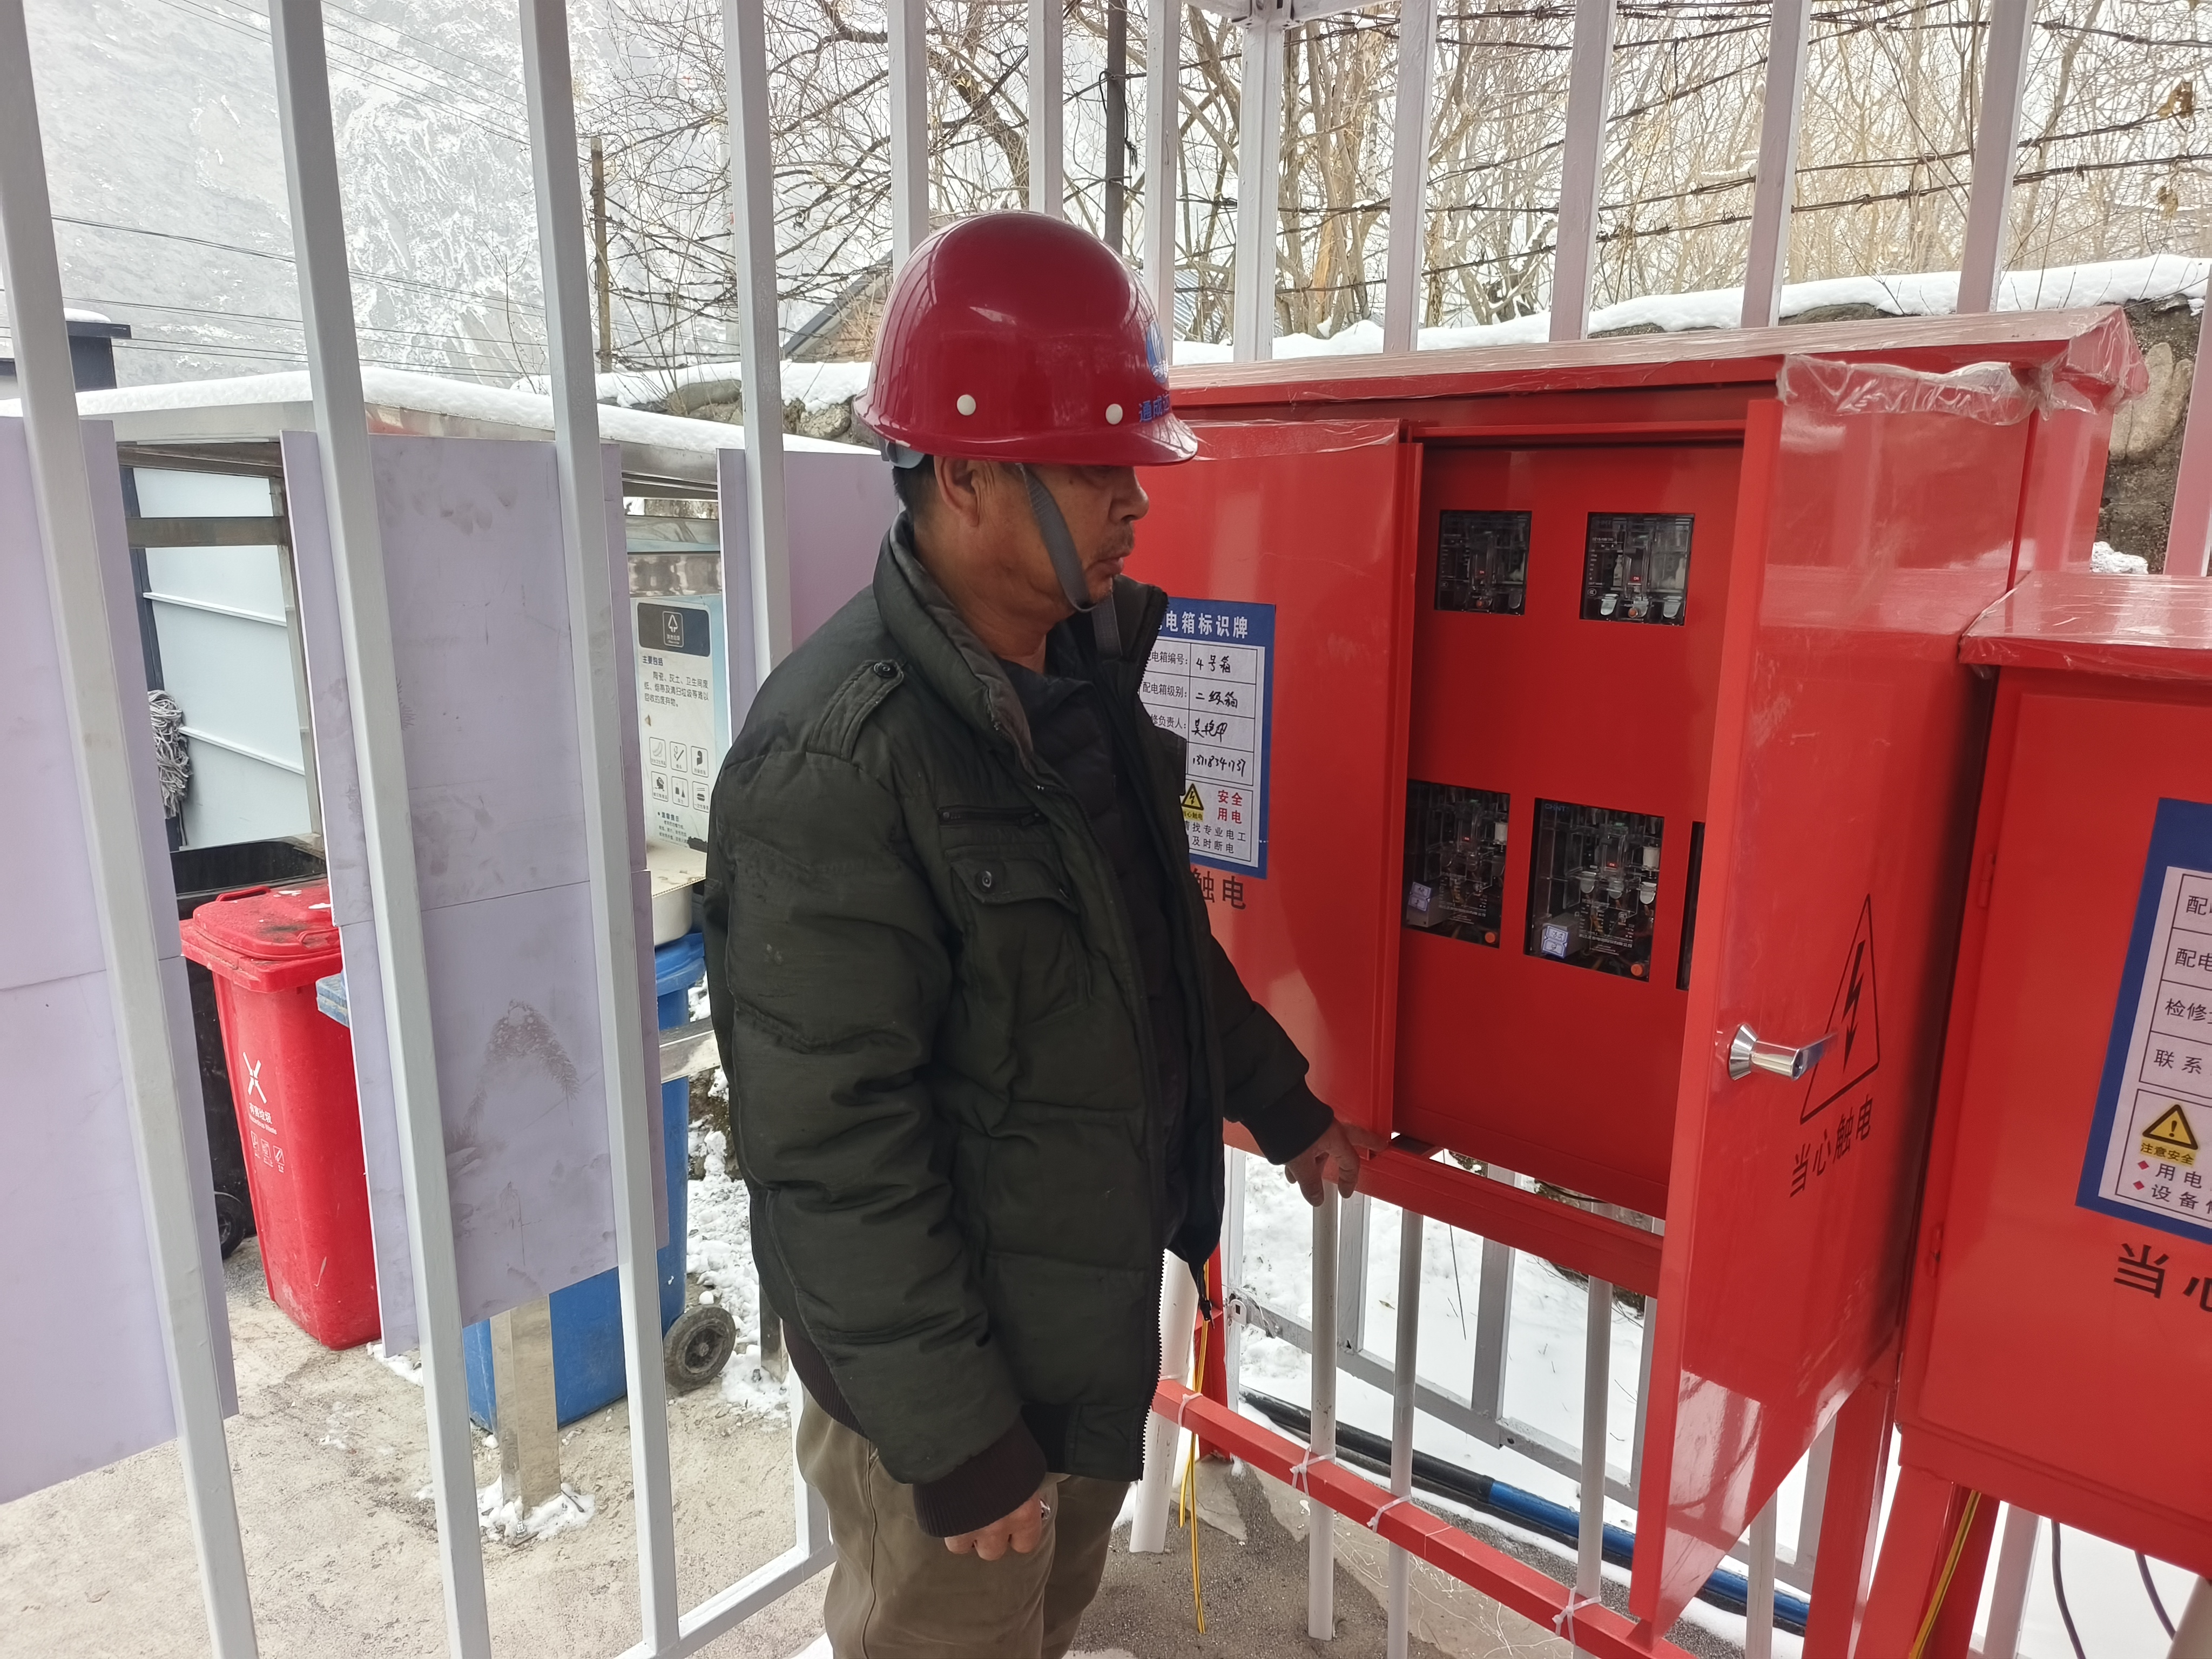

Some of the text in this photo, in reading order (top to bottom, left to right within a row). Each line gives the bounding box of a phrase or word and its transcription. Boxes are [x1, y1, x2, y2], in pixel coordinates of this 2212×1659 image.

[1158, 610, 1249, 639] 电箱标识牌
[642, 655, 663, 666] 主要包括
[1196, 655, 1231, 673] 4号箱
[1143, 682, 1187, 698] 配电箱级别：
[1195, 690, 1238, 708] 二级箱
[1218, 790, 1243, 806] 安全
[1217, 807, 1242, 824] 用电
[1192, 835, 1234, 854] 及时断电
[2186, 895, 2212, 916] 配
[2164, 997, 2212, 1025] 检修
[2154, 1049, 2202, 1075] 联系
[1789, 1094, 1873, 1198] 当心触电
[2140, 1143, 2194, 1166] 注意安全
[2151, 1184, 2212, 1215] 设备
